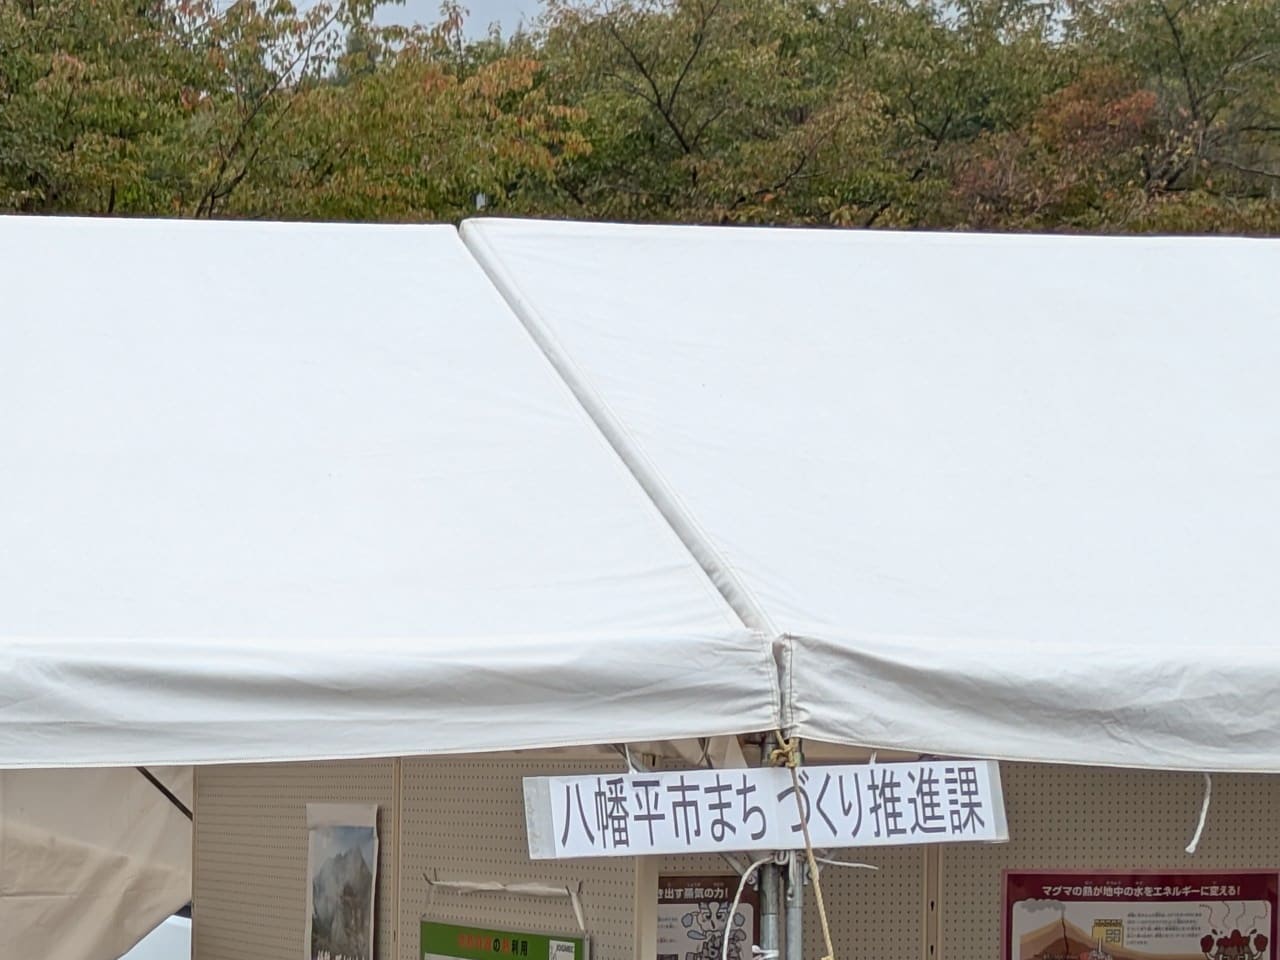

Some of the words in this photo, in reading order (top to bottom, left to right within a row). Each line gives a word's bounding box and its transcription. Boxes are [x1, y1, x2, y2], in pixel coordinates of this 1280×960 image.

[561, 767, 986, 849] 八幡平市まちづくり推進課
